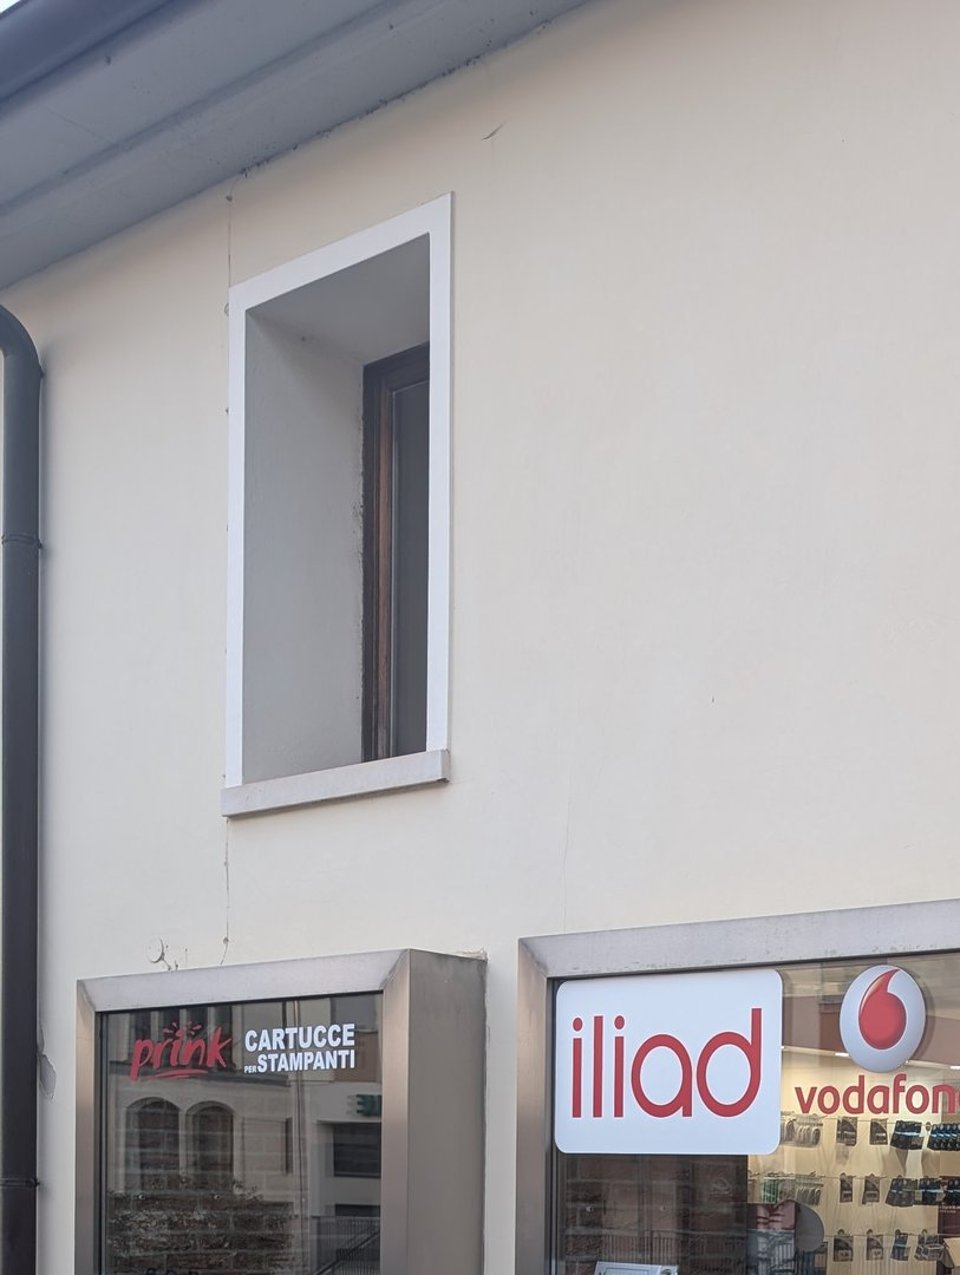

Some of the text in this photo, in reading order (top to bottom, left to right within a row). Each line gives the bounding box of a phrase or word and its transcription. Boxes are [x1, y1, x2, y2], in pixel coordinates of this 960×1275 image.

[128, 1026, 232, 1081] prink
[245, 1024, 355, 1052] CARTUCCE
[244, 1050, 355, 1074] PER STAMPANTI
[571, 1007, 763, 1118] iliad
